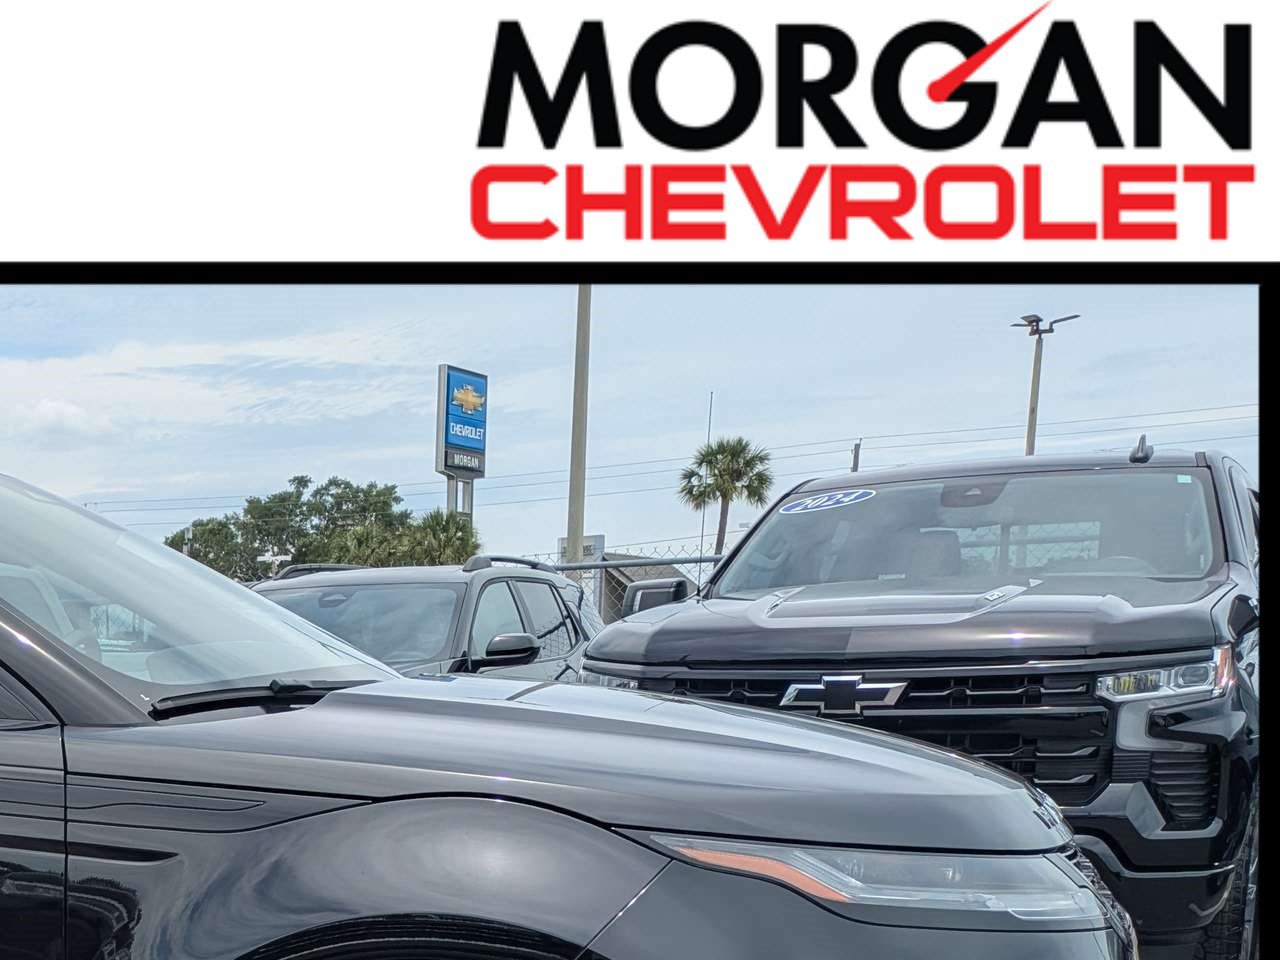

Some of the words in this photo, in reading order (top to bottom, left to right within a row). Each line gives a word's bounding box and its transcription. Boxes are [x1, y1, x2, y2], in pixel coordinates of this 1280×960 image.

[449, 422, 484, 440] CHEVROLET
[454, 453, 479, 468] MORGAN
[791, 490, 863, 511] 2024
